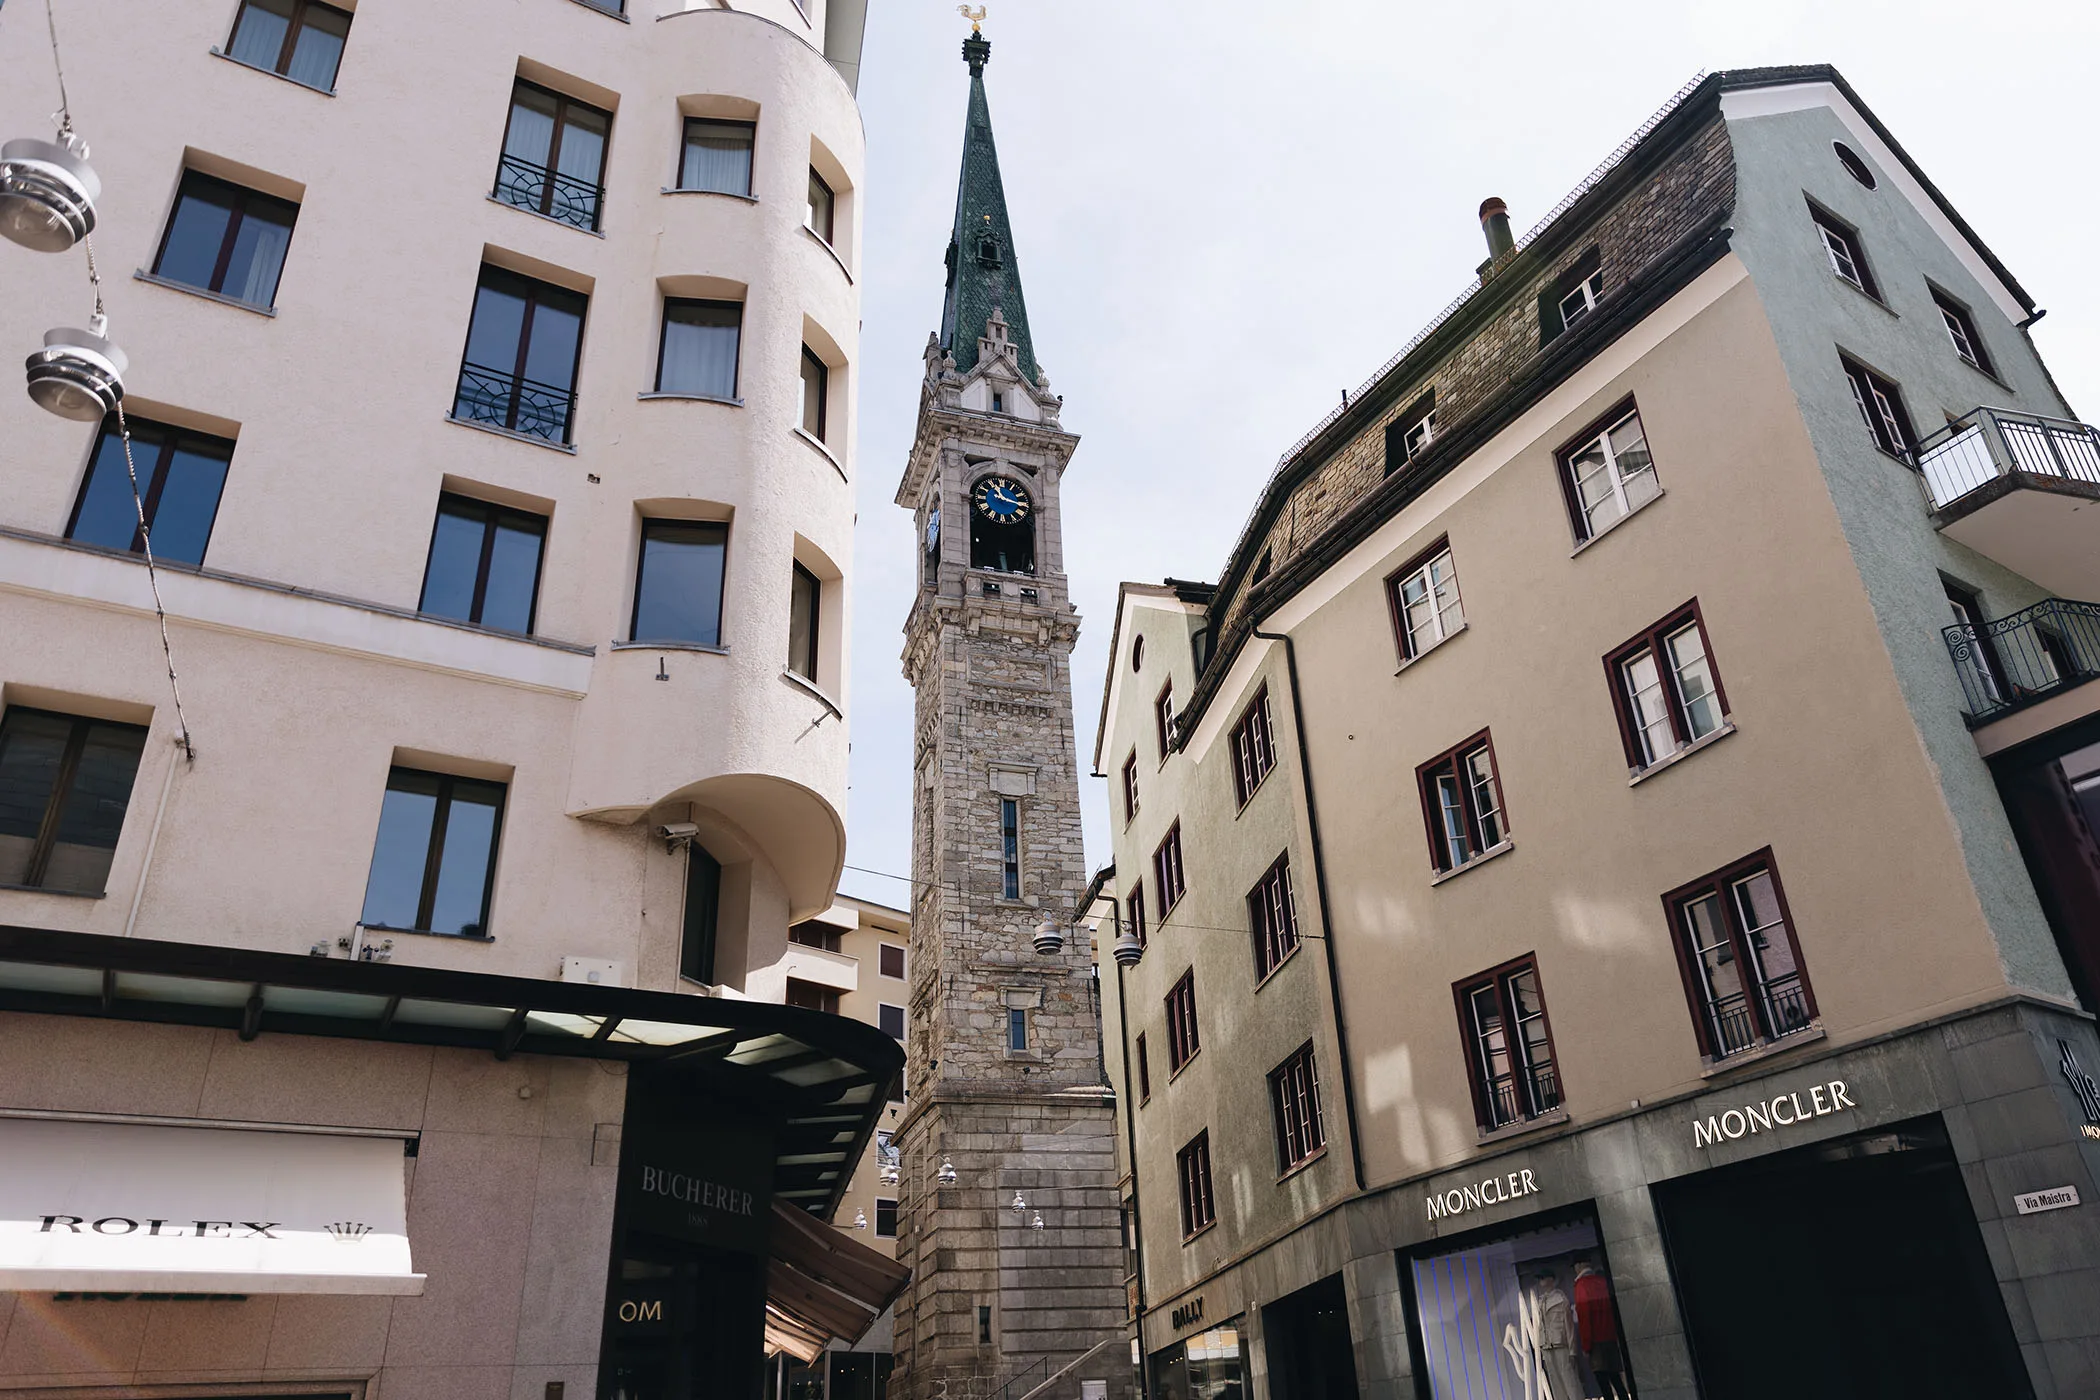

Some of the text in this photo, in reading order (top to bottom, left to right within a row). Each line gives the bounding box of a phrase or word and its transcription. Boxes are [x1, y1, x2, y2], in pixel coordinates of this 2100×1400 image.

[1692, 1079, 1857, 1149] MONCLER
[641, 1165, 754, 1217] BUCHERER
[1425, 1167, 1541, 1221] MONCLER
[2023, 1192, 2071, 1209] Via Maistra
[38, 1215, 283, 1239] ROLEX
[618, 1299, 663, 1323] OM
[1172, 1296, 1204, 1330] BALLY
